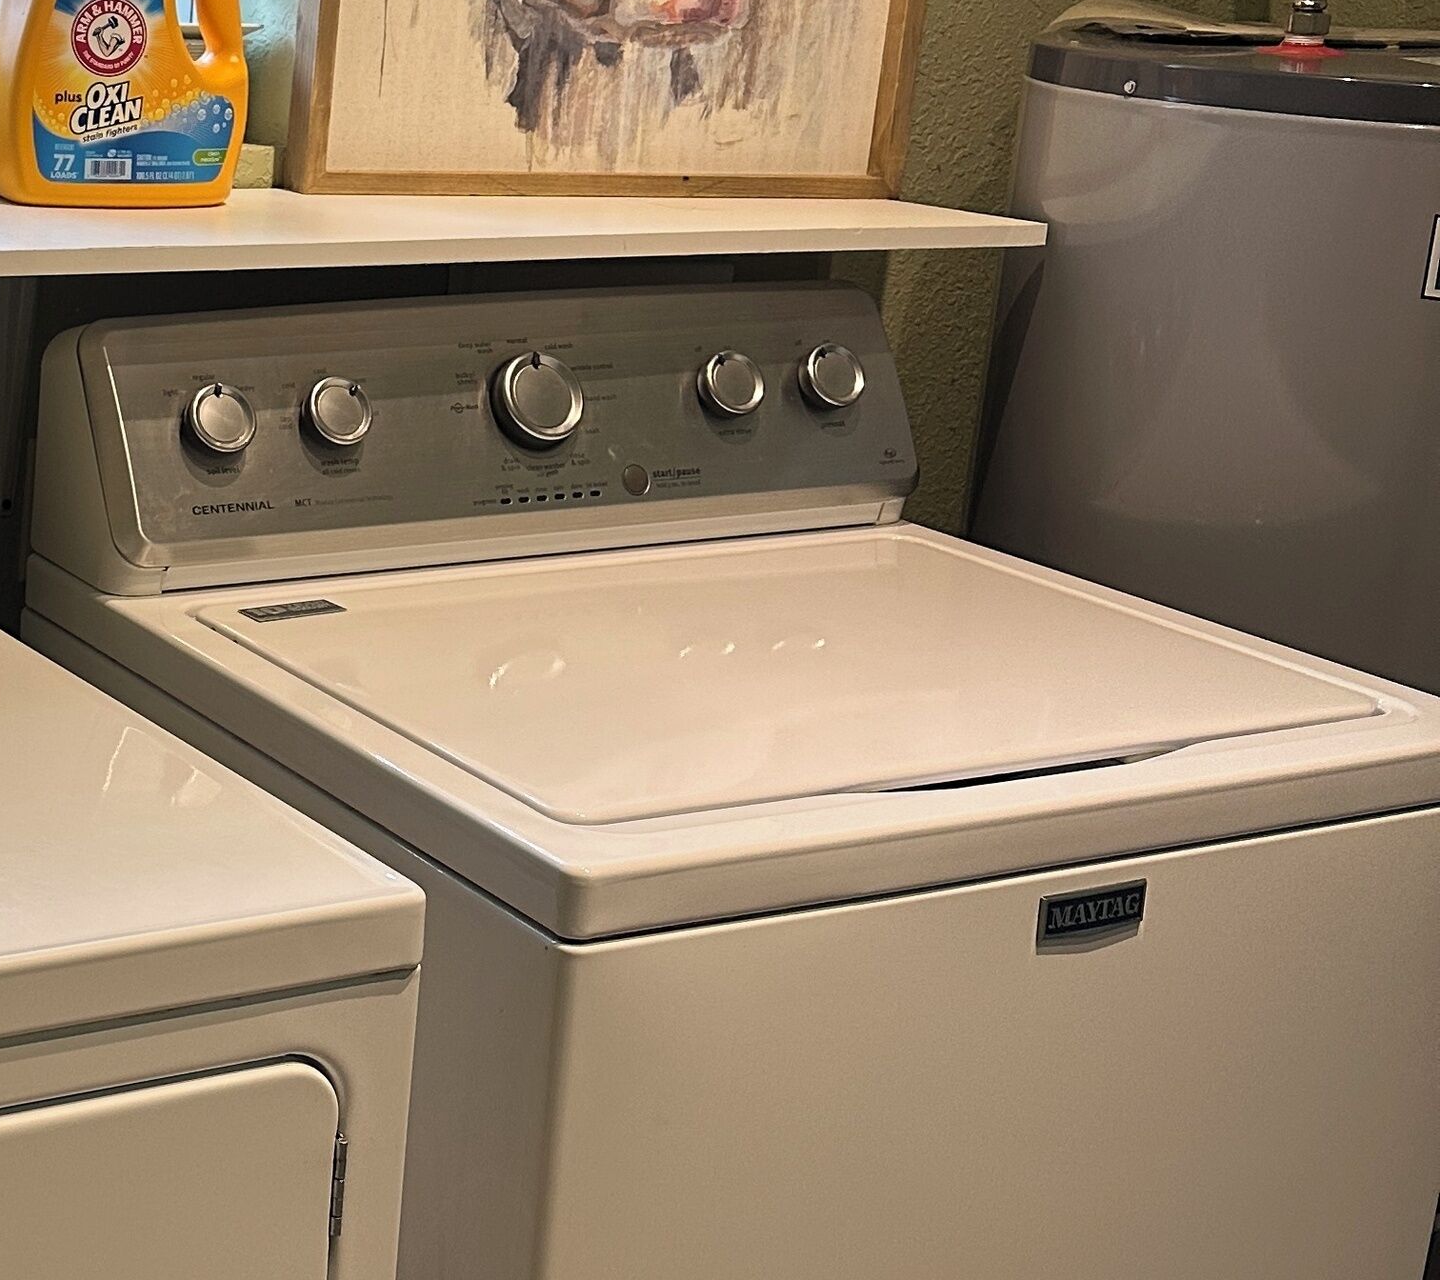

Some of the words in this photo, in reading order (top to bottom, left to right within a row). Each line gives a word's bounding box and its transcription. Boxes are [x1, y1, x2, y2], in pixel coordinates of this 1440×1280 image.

[75, 11, 94, 43] ARM
[92, 4, 103, 17] &
[103, 0, 144, 45] HAMMER
[54, 90, 82, 105] plus
[86, 81, 130, 110] OXI
[70, 98, 143, 135] CLEAN
[82, 131, 104, 143] stain
[105, 124, 138, 139] fighters
[53, 153, 76, 171] 77
[191, 499, 276, 516] CENTENNIAL
[1048, 893, 1140, 930] MAYTAG
